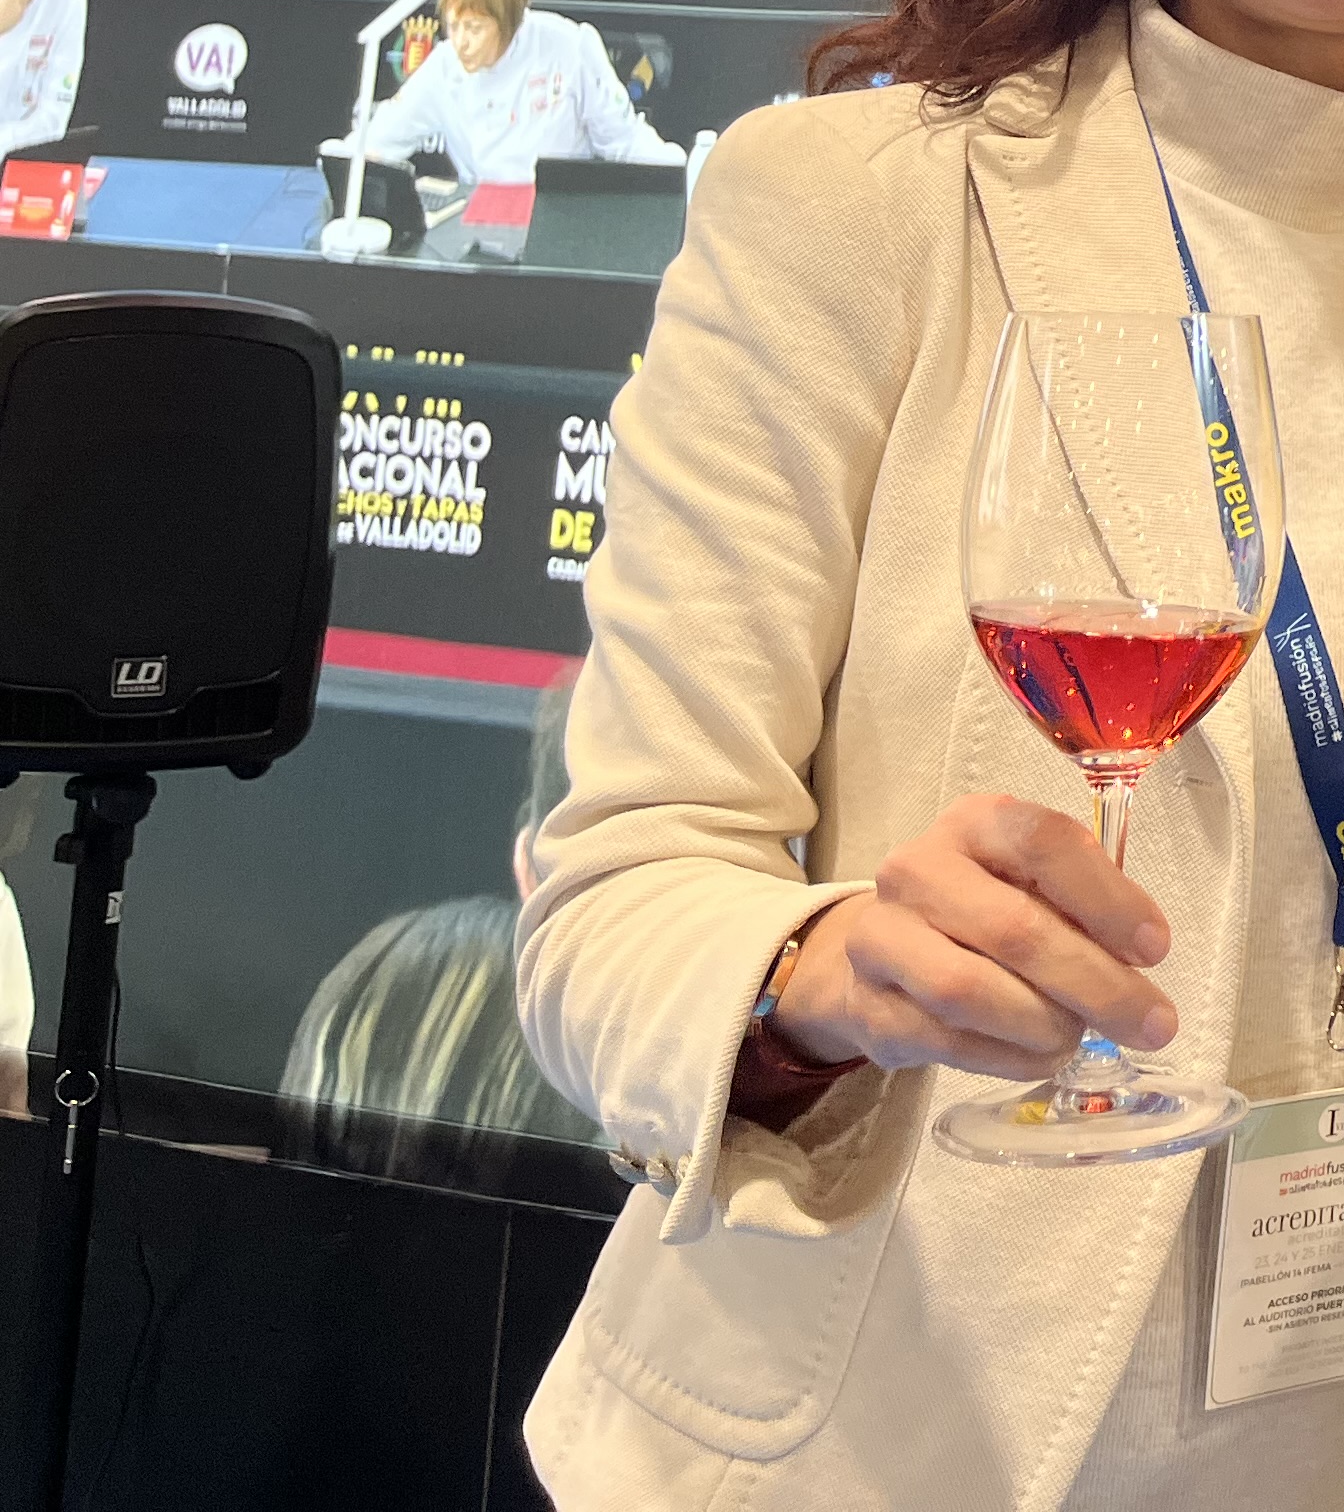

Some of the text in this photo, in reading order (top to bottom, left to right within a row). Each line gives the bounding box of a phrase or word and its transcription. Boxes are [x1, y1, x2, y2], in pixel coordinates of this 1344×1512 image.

[1205, 421, 1257, 540] makro
[410, 493, 484, 525] TAPAS
[354, 513, 483, 557] VALLADOLID
[550, 508, 595, 554] DE
[117, 662, 163, 685] LD
[1243, 1316, 1256, 1328] AL
[1258, 1305, 1314, 1324] AUDITORIO
[1268, 1292, 1309, 1310] ACCESO
